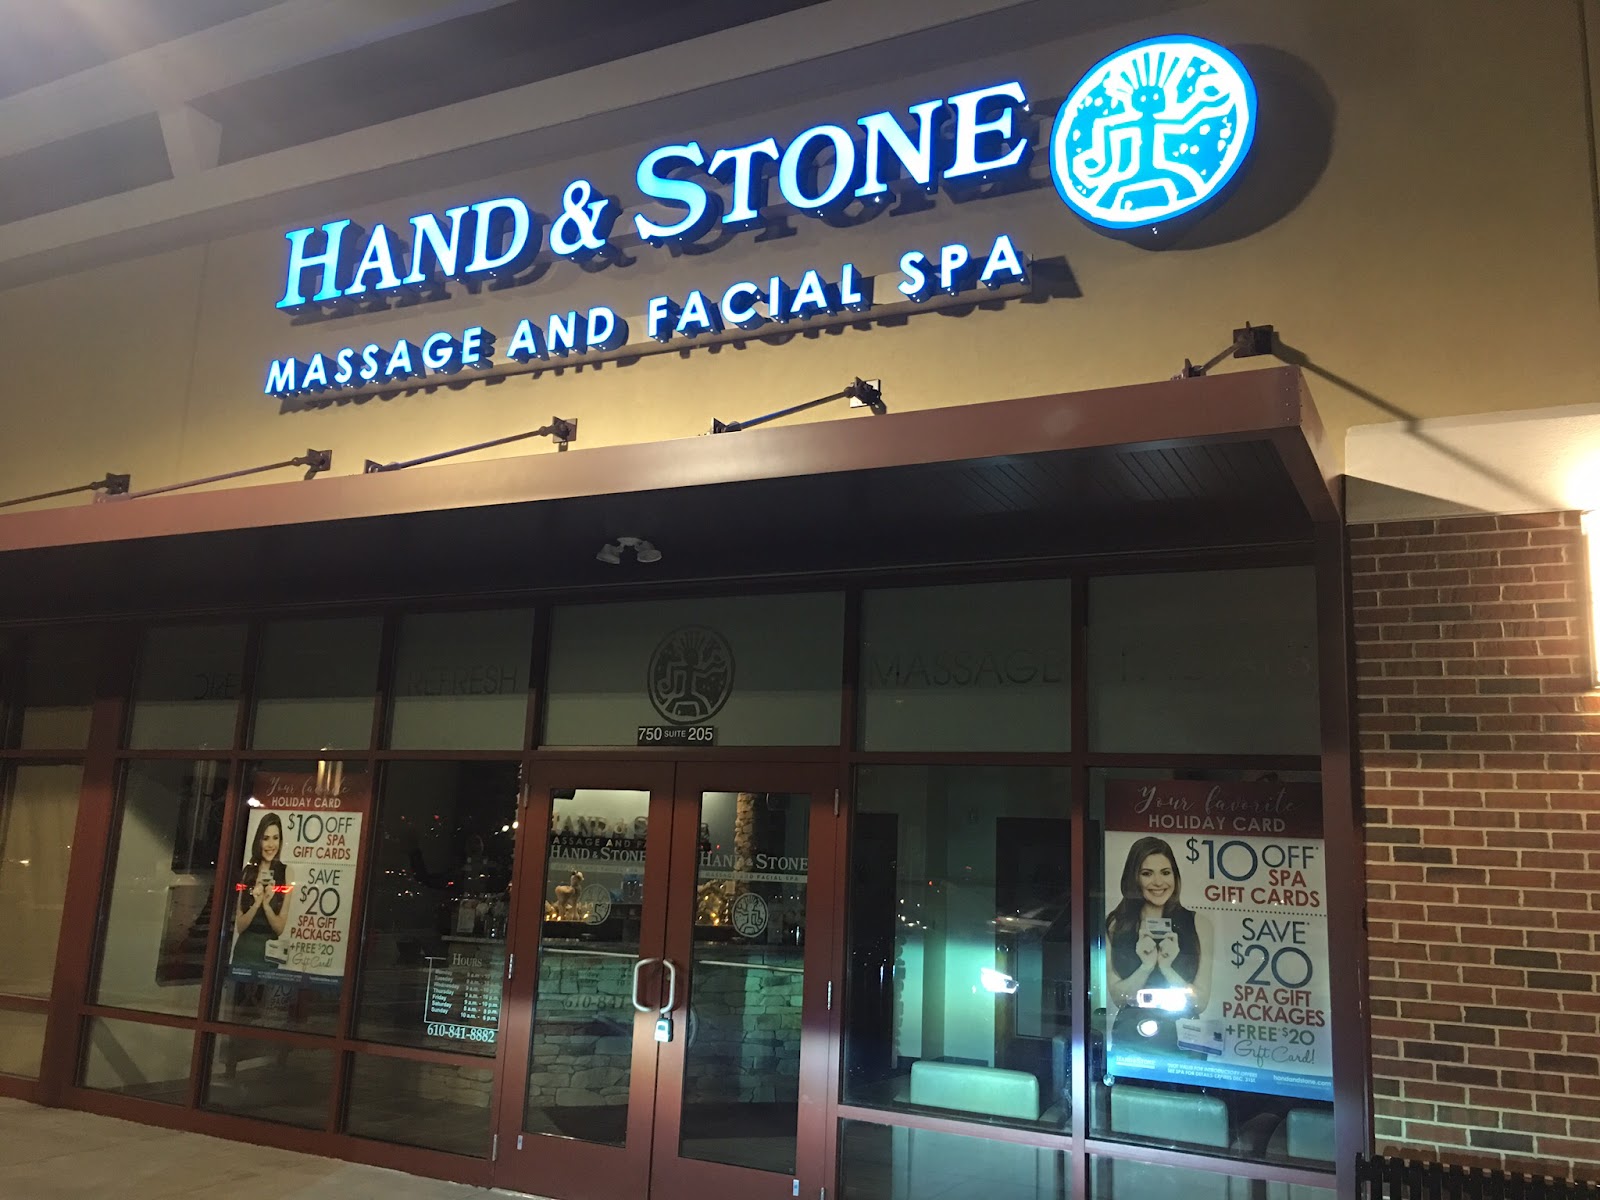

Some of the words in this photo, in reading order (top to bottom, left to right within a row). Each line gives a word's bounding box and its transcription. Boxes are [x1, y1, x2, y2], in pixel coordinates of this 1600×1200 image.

[276, 197, 530, 309] HAND
[549, 180, 608, 255] &
[634, 82, 1028, 240] STONE
[264, 327, 483, 393] MASSAGE
[507, 306, 615, 357] AND
[648, 264, 861, 337] FACIAL
[898, 235, 1022, 295] SPA
[638, 727, 662, 741] 750
[664, 730, 686, 738] SUITE
[687, 727, 713, 741] 205
[271, 796, 311, 808] HOLIDAY
[314, 797, 341, 809] CARD
[1134, 784, 1195, 815] Your
[1204, 784, 1303, 815] favorite
[287, 813, 324, 844] $10
[1149, 814, 1226, 831] HOLIDAY
[1233, 816, 1286, 833] CARD
[326, 834, 346, 847] SPA
[292, 845, 314, 858] GIFT
[315, 846, 351, 861] CARDS
[551, 845, 590, 860] HAND
[592, 850, 598, 859] &
[756, 853, 808, 871] STONE
[1185, 836, 1259, 882] $10
[1268, 869, 1307, 888] SPA
[299, 885, 341, 917] $20
[1204, 885, 1246, 904] GIFT
[1250, 886, 1320, 908] CARDS
[297, 915, 315, 927] SPA
[317, 917, 337, 929] GIFT
[290, 928, 341, 943] PACKAGES
[1230, 940, 1314, 989] $20
[1233, 984, 1269, 1004] SPA
[1273, 988, 1312, 1008] GIFT
[1222, 1001, 1326, 1028] PACKAGES
[427, 1023, 495, 1044] 610-841-8882
[1281, 1027, 1315, 1047] $20
[1233, 1039, 1270, 1068] Gift
[1271, 1045, 1316, 1065] Card!
[1273, 1075, 1332, 1087] handandstone.com
